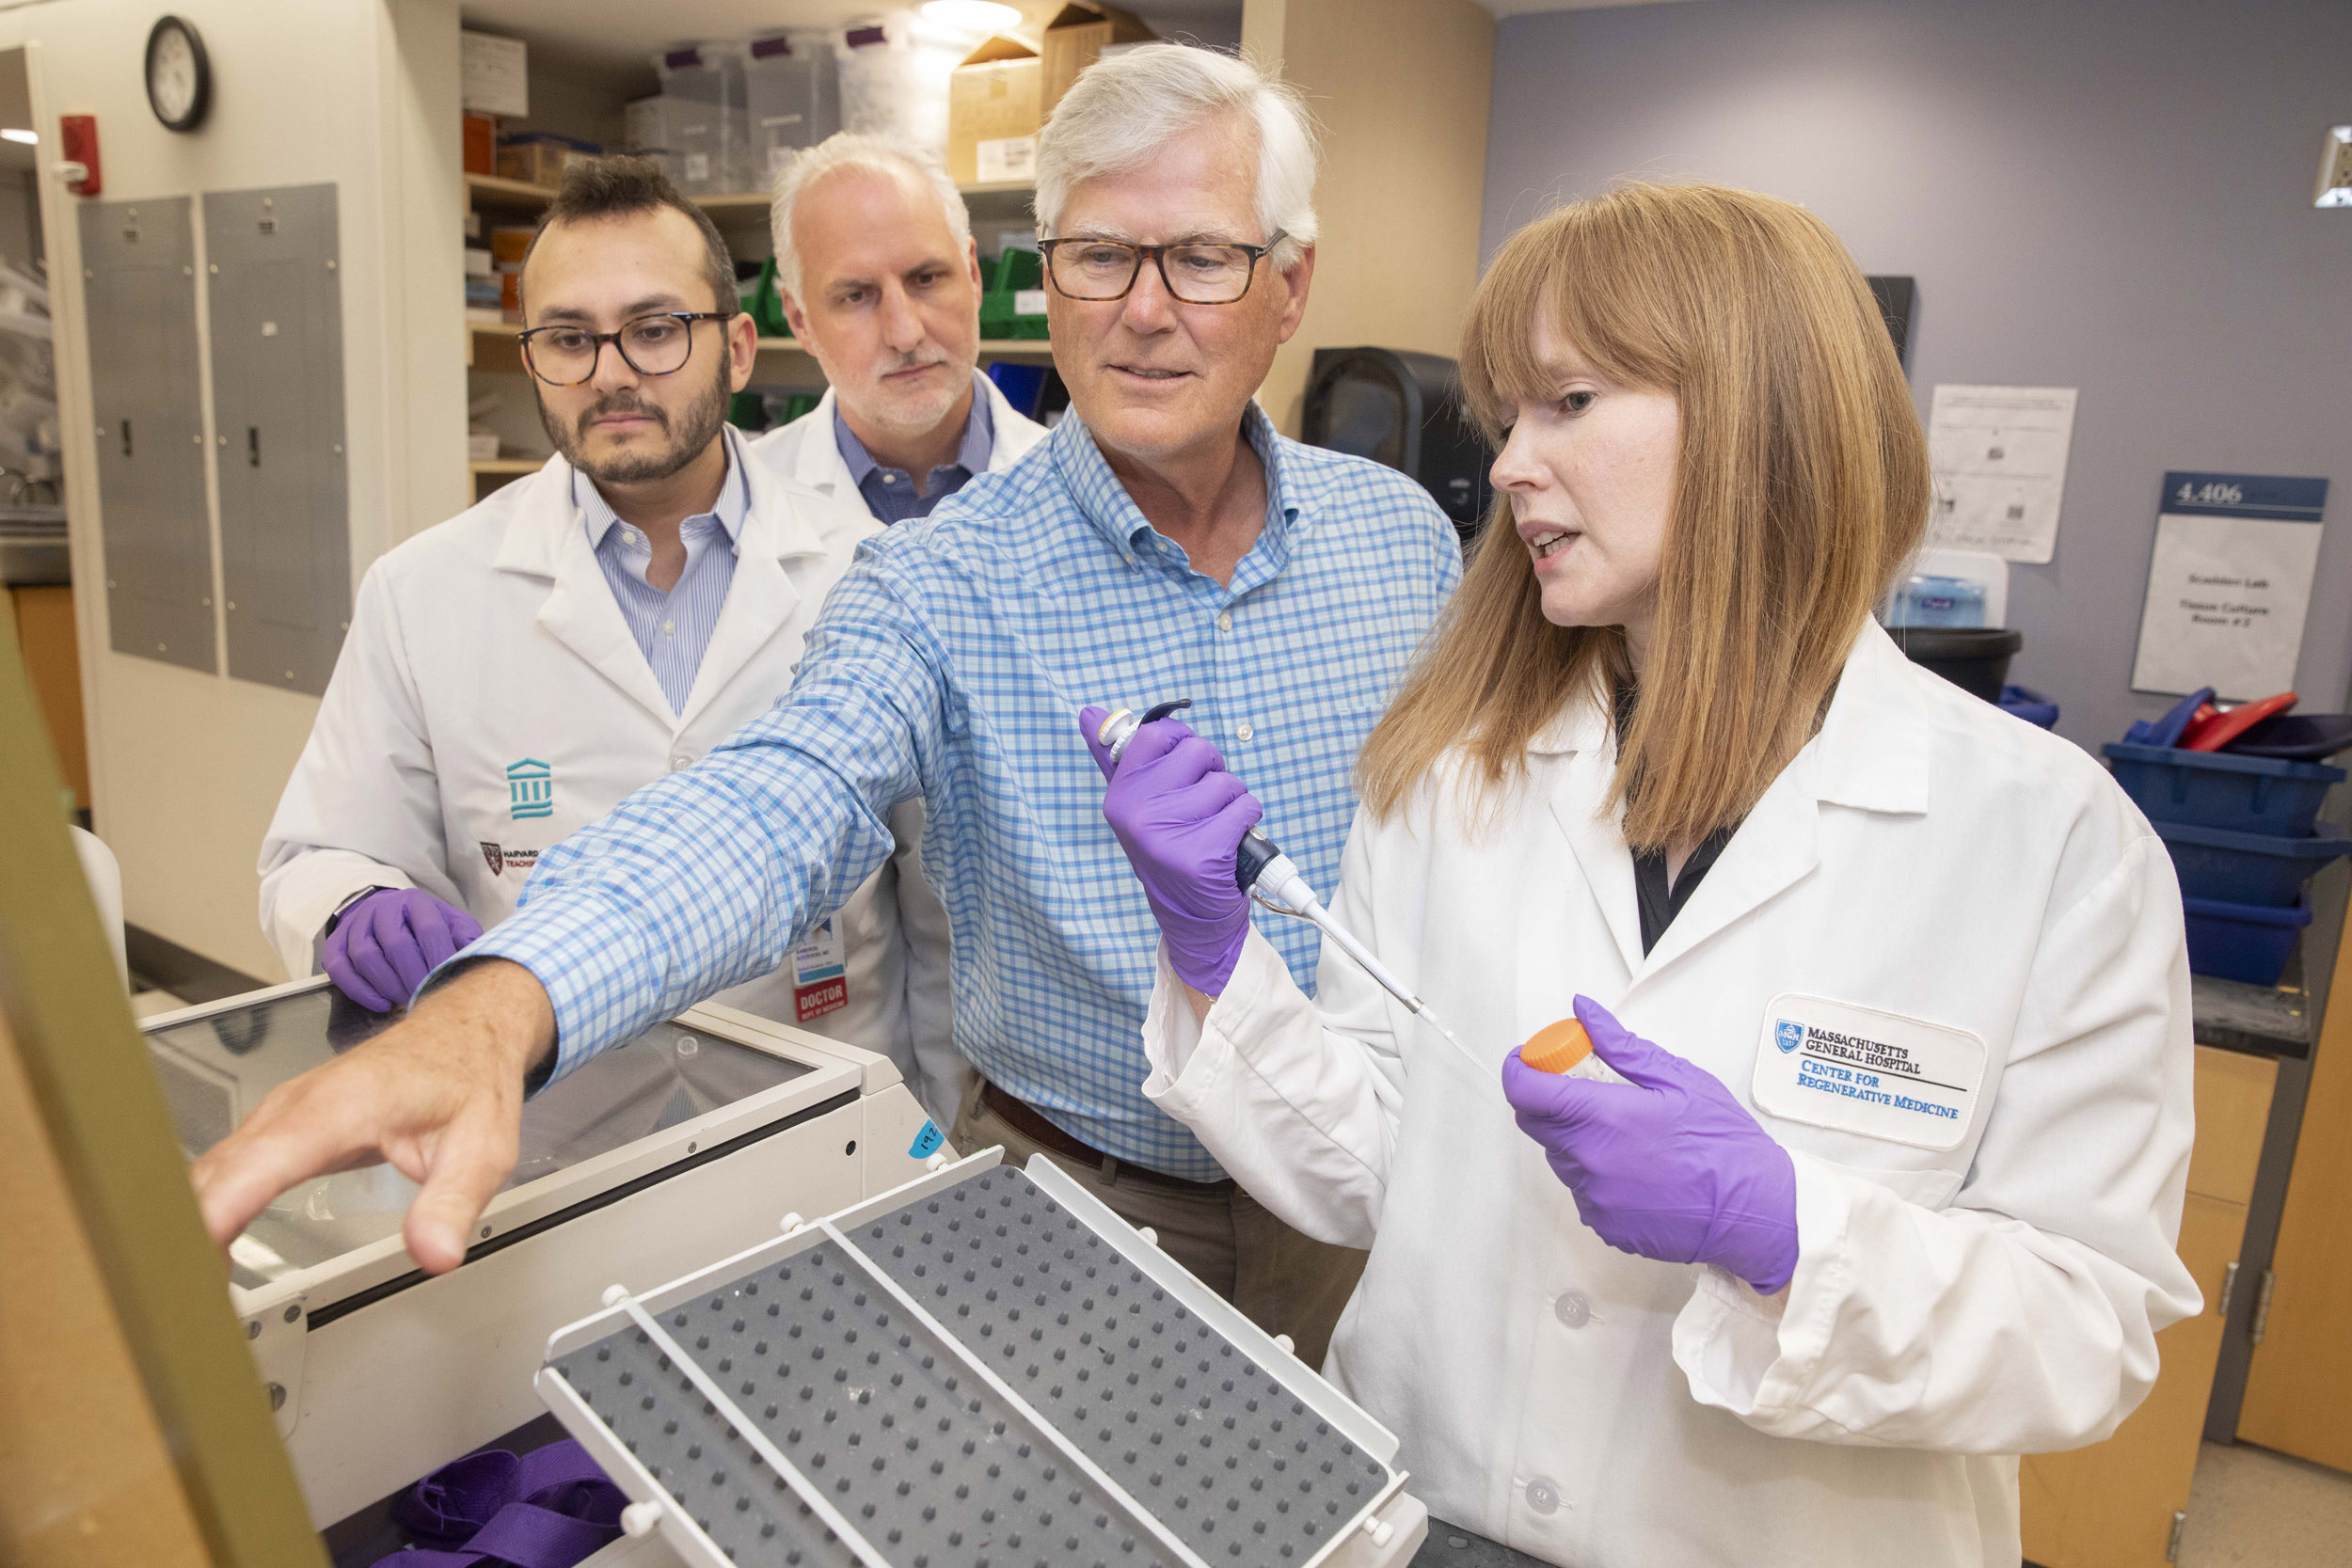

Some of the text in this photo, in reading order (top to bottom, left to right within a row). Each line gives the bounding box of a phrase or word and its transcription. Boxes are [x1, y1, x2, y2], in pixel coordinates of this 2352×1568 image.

[2176, 481, 2244, 504] 4.406
[800, 985, 843, 1010] DOCTOR
[1805, 1039, 1921, 1075] GENERAL HOSPITAL
[1807, 1026, 1909, 1059] MASSACHUSETTS
[1801, 1059, 1880, 1088] CENTER FOR
[1797, 1072, 1959, 1119] REGENERATIVE MEDICINE
[920, 1127, 939, 1150] 192
